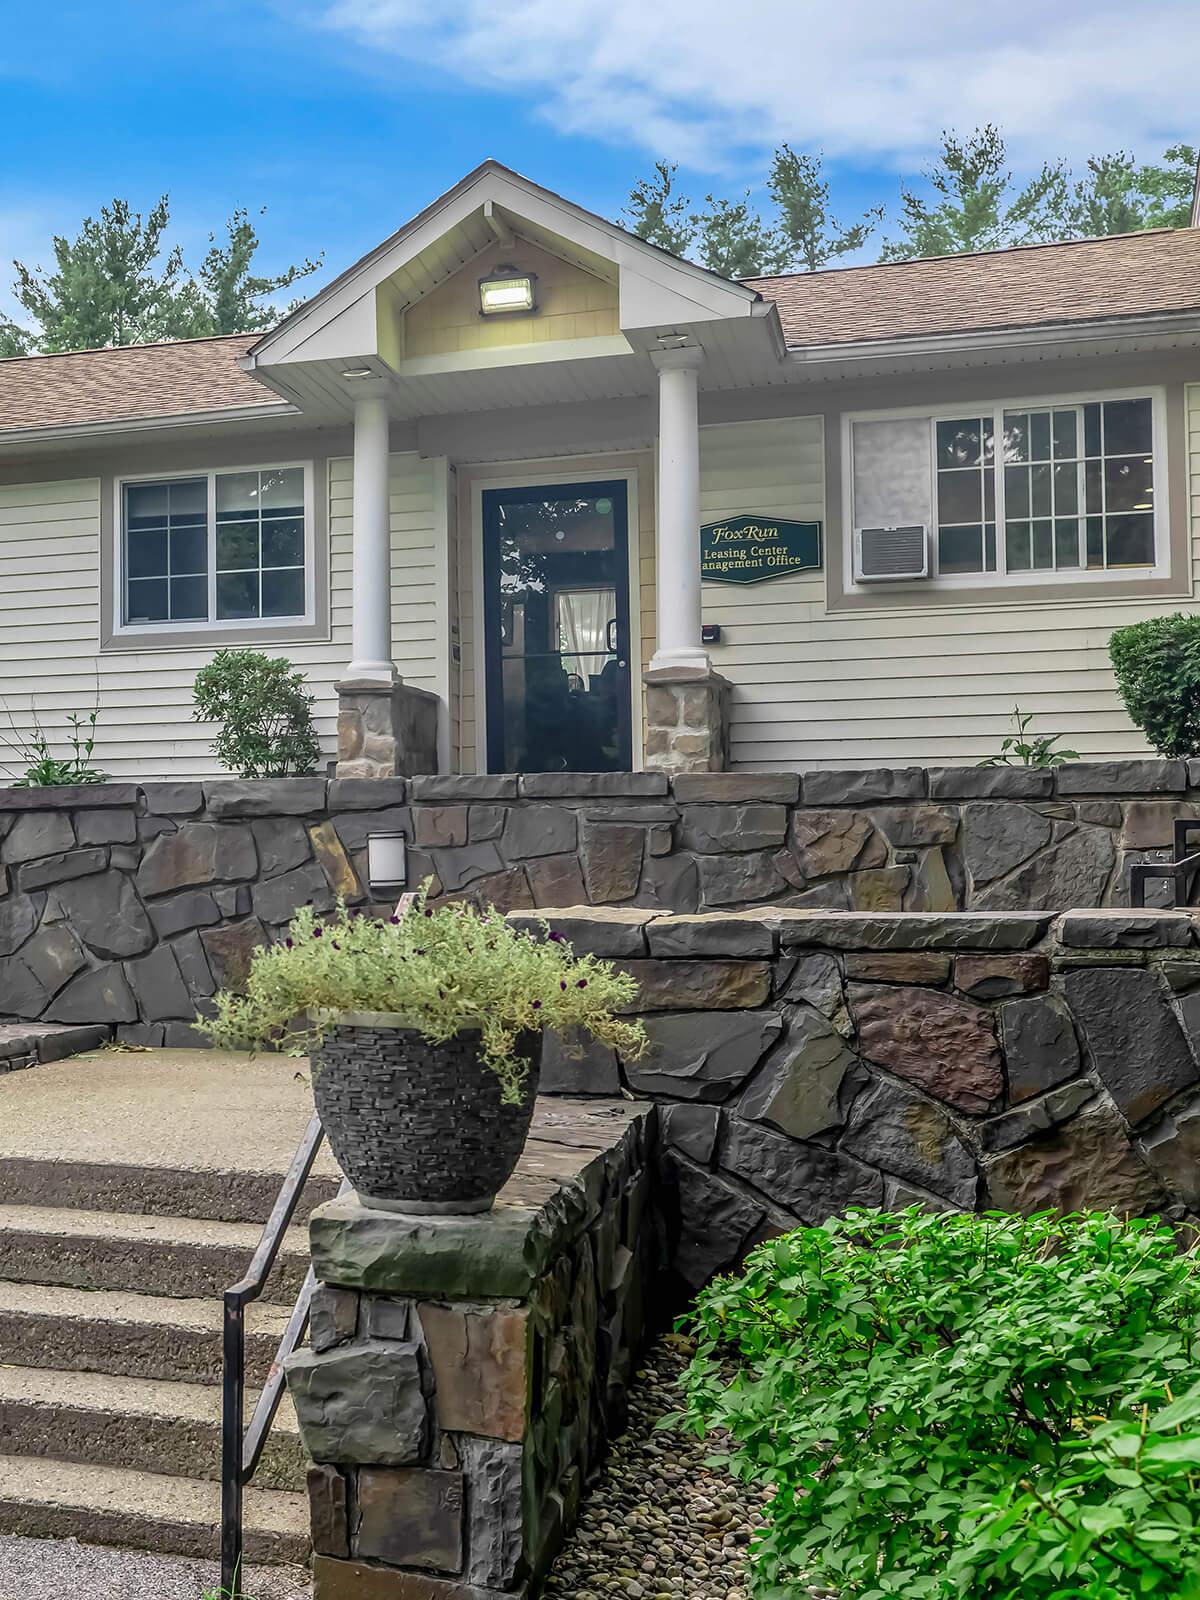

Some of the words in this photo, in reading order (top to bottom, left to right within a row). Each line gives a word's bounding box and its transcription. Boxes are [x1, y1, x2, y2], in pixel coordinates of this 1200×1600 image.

[704, 548, 747, 559] Leasing
[750, 546, 788, 556] Center
[701, 559, 762, 572] anagement
[767, 555, 801, 566] Office
